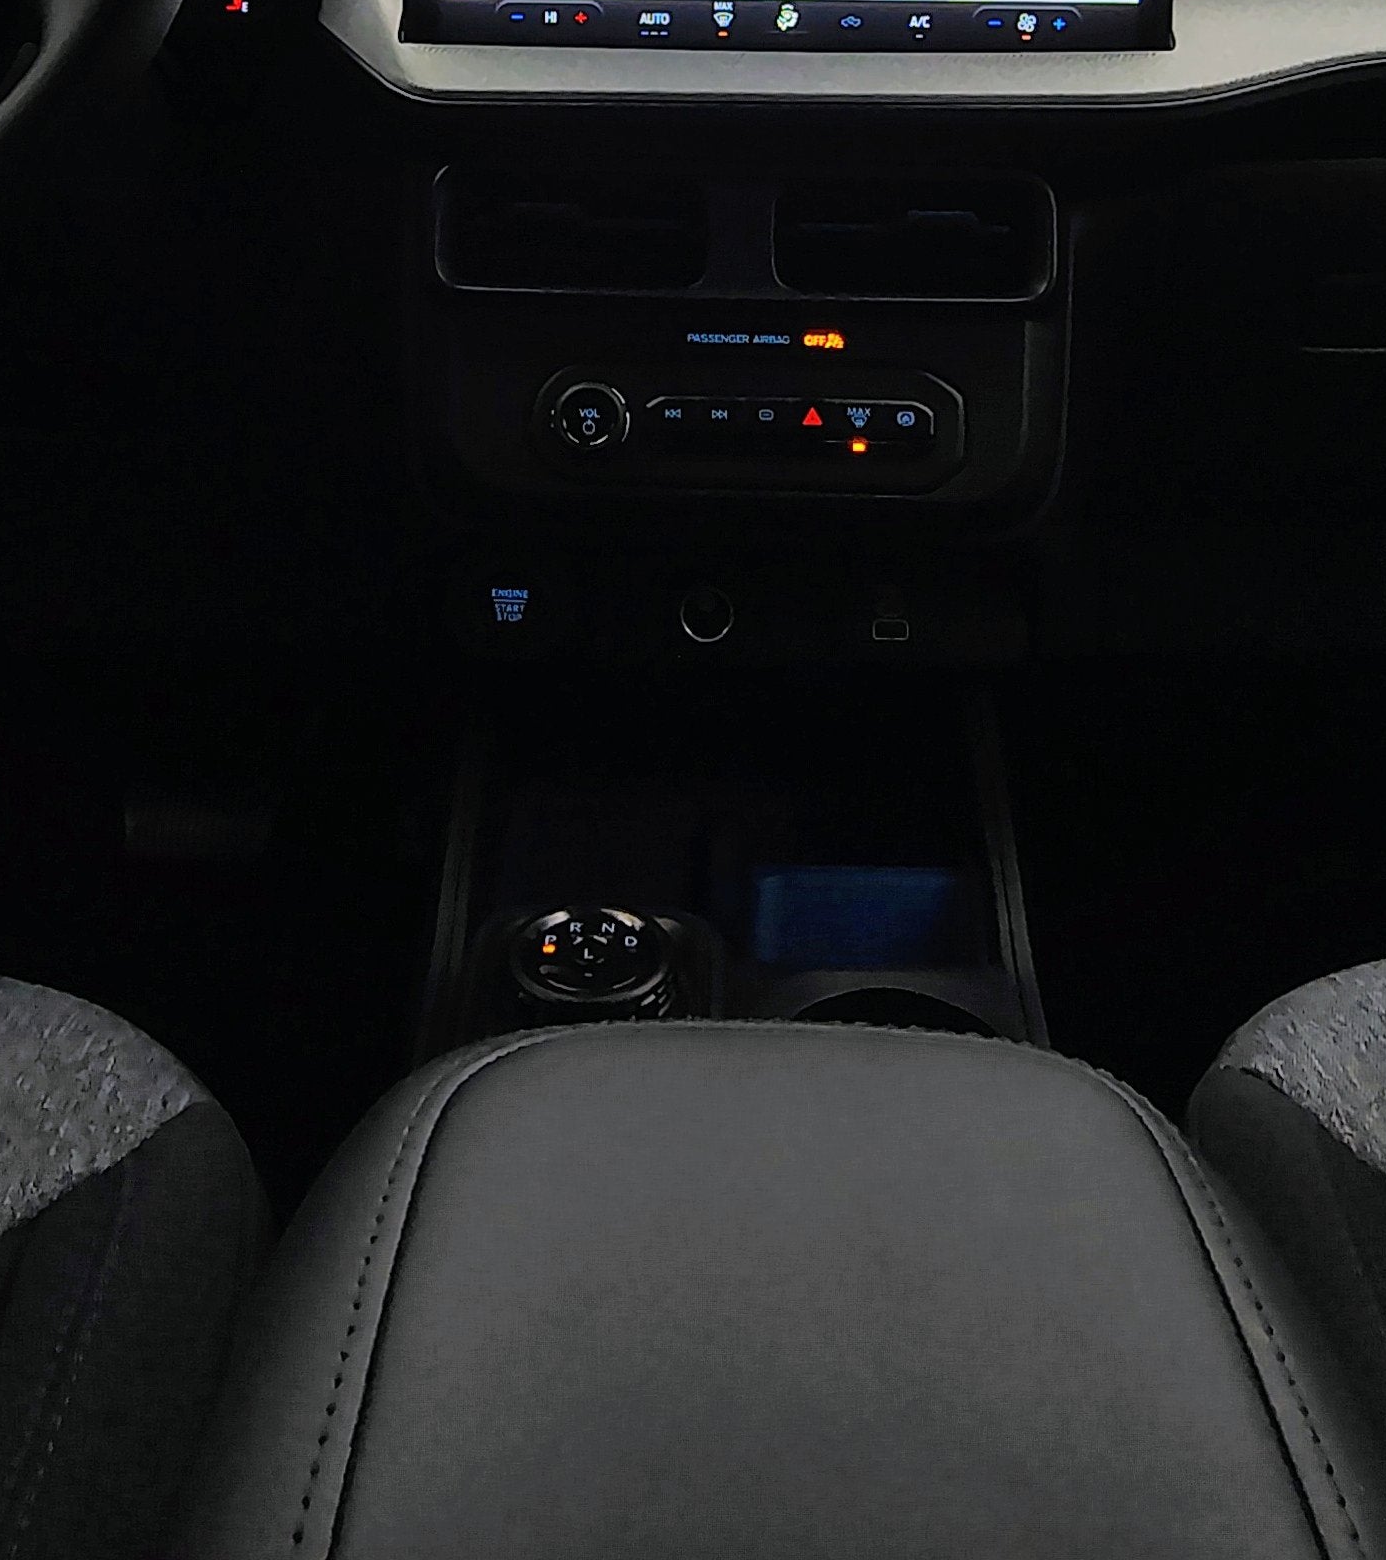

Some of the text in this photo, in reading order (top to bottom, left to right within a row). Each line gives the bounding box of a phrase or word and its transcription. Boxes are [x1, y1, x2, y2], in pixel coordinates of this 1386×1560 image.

[713, 1, 734, 11] MAX
[639, 13, 670, 25] AUTO
[909, 16, 931, 28] A/C
[687, 333, 750, 344] PASSENGER
[752, 334, 791, 345] AIRBAG
[579, 408, 601, 418] VOL
[847, 407, 871, 417] MAX
[491, 588, 529, 599] ENGINE
[495, 603, 525, 612] START
[569, 922, 583, 932] R
[601, 922, 615, 933] N
[544, 935, 557, 946] P
[624, 935, 638, 947] D
[584, 948, 594, 959] L
